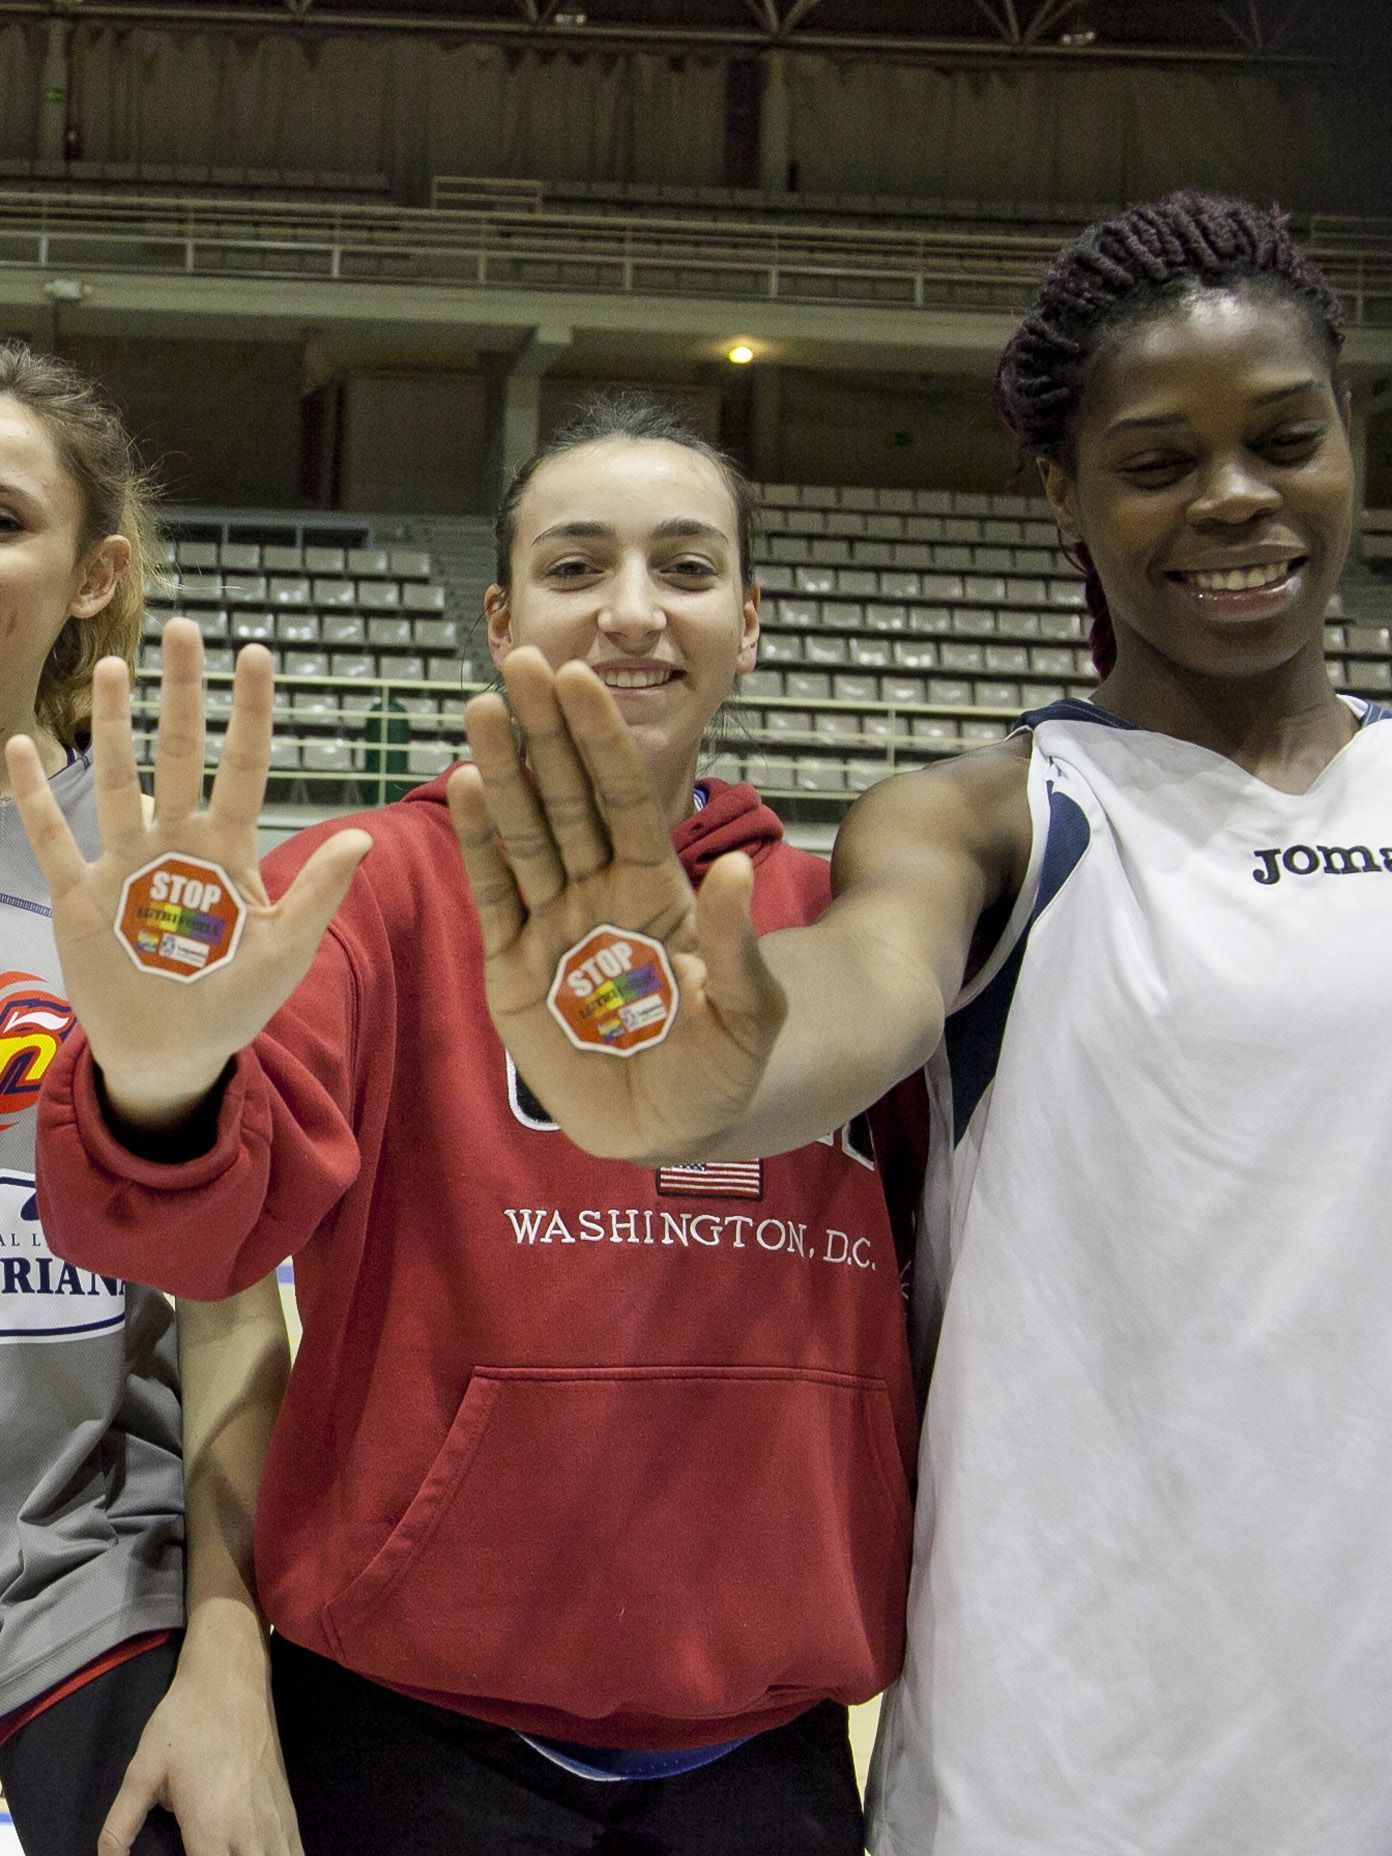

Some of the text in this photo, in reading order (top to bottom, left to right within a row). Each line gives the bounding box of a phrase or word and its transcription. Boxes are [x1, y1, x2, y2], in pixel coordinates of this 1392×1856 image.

[149, 871, 222, 912] STOP
[567, 942, 633, 997] STOP
[504, 1209, 877, 1272] WASHINGTON, D.C.
